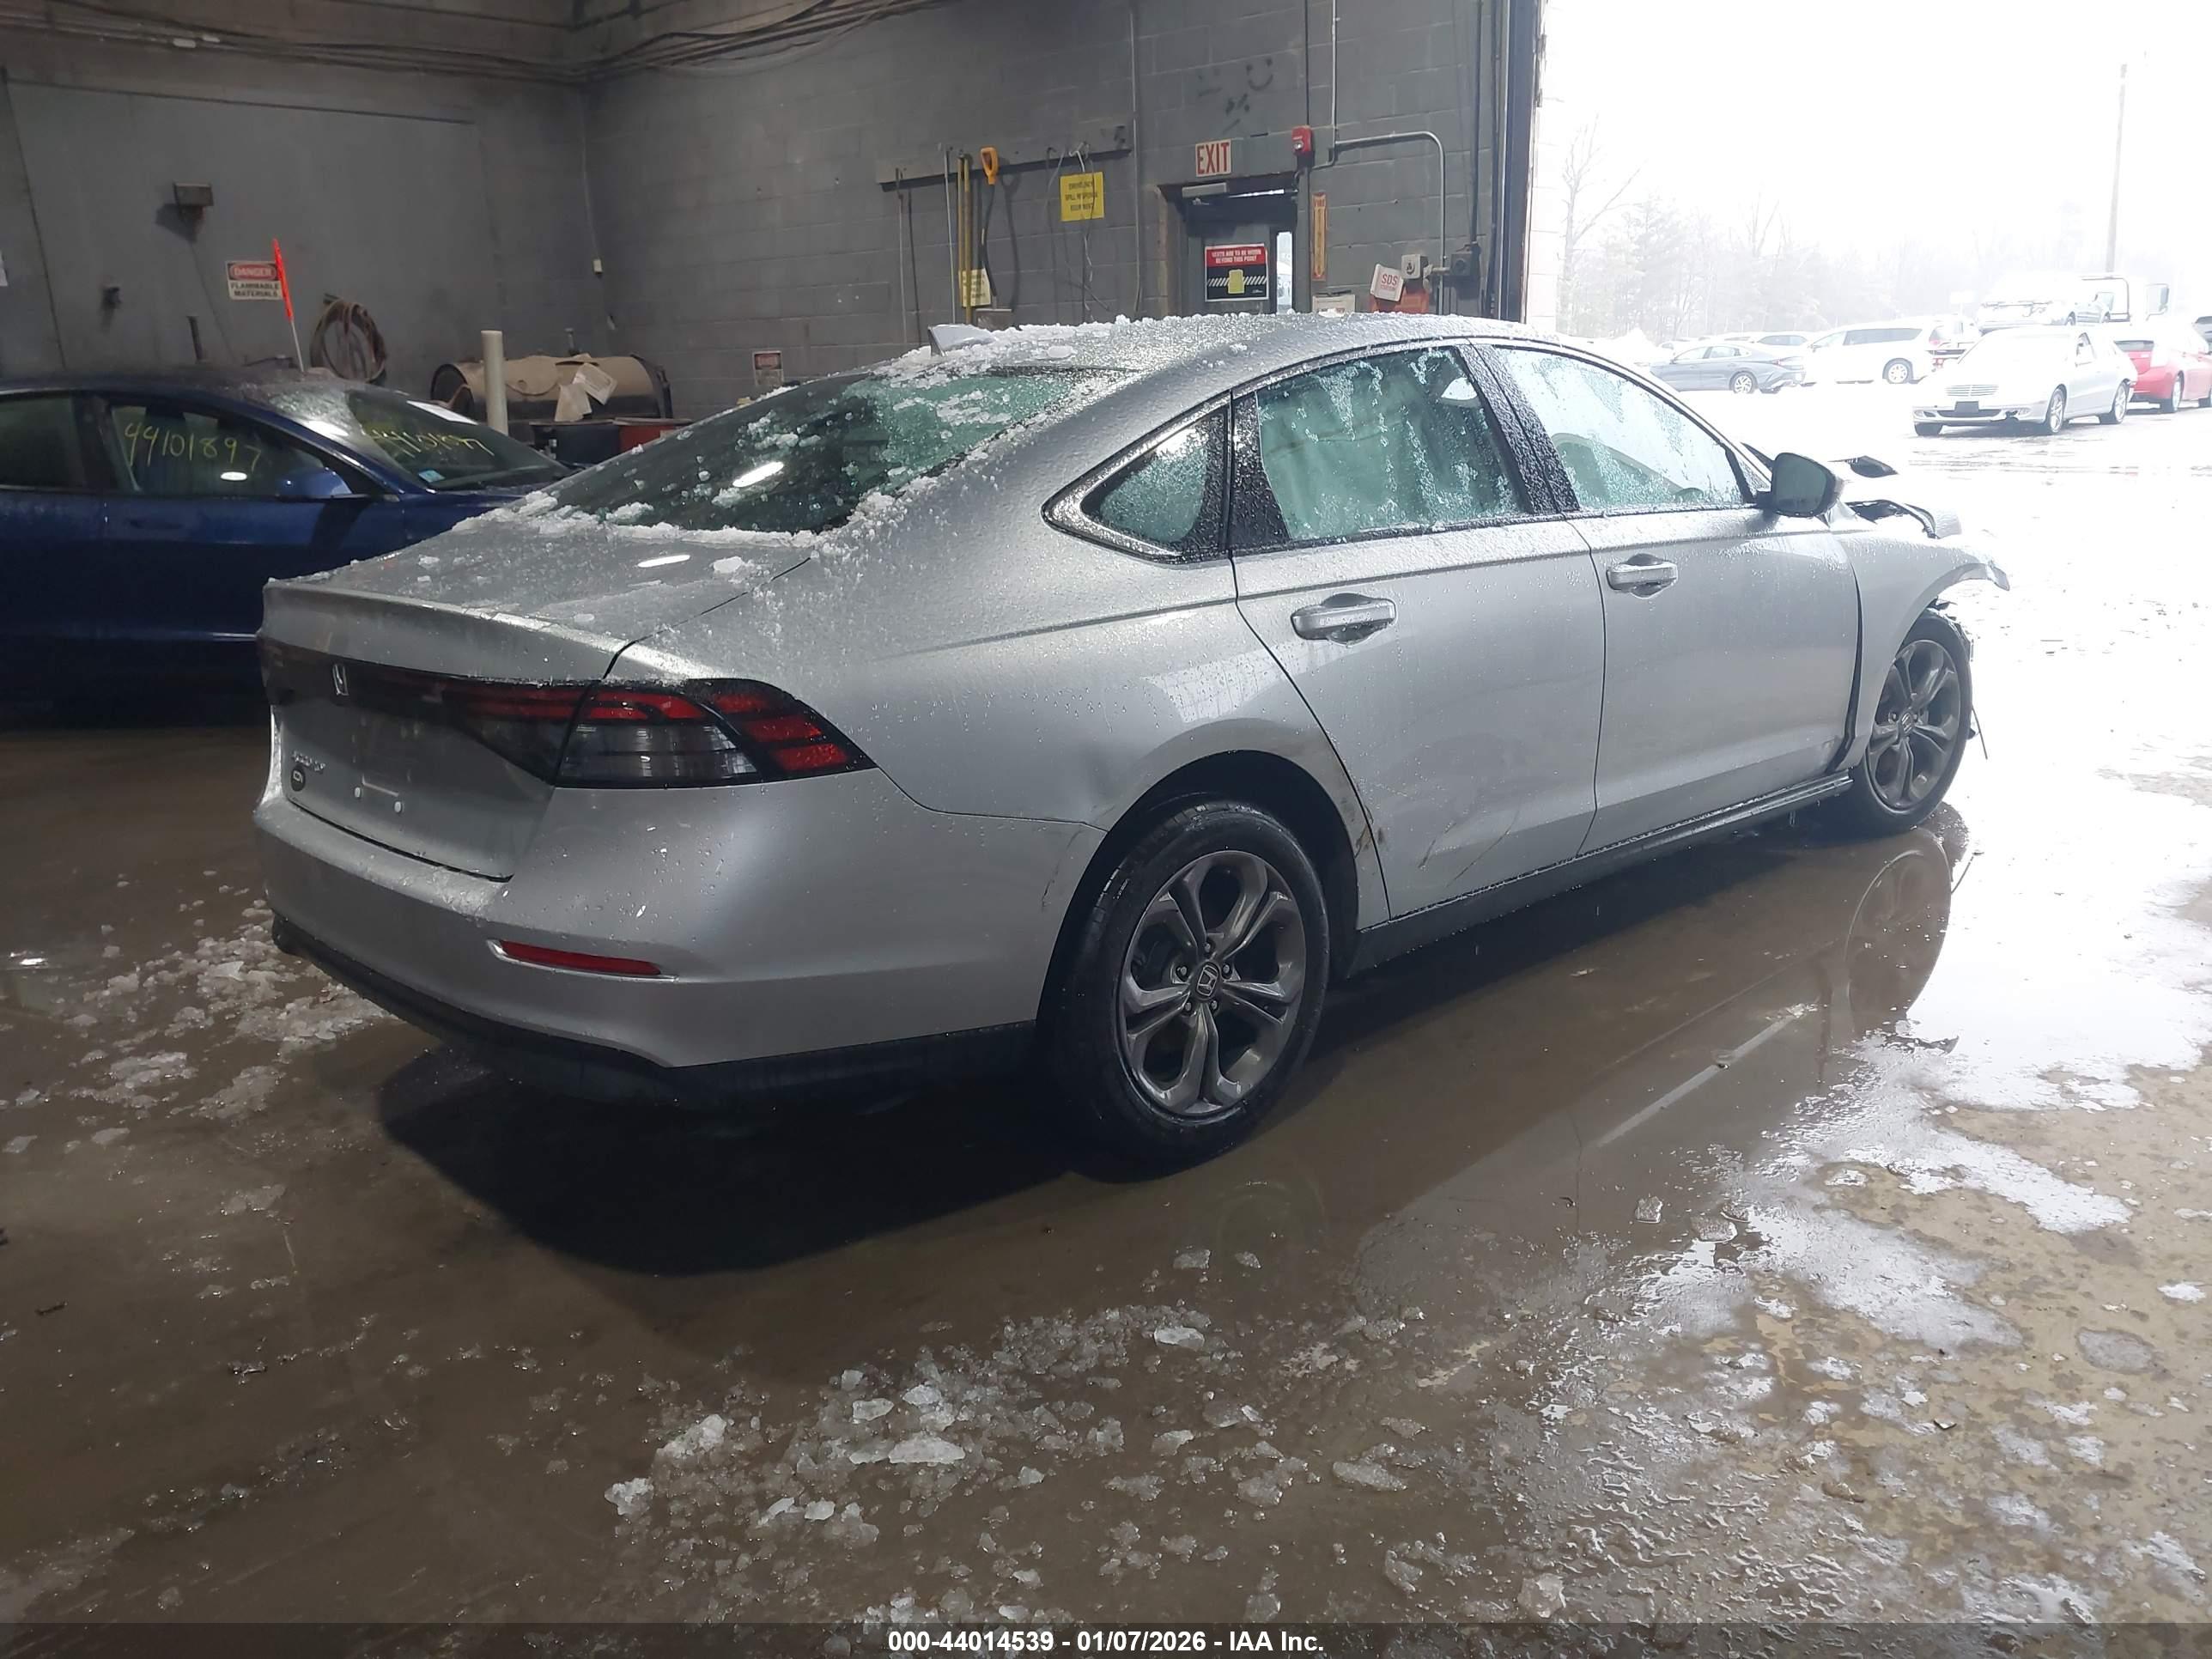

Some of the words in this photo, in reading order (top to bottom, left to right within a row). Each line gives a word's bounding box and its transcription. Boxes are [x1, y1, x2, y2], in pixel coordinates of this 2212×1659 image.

[1196, 142, 1230, 174] EXIT
[234, 267, 273, 276] DANGER
[1381, 273, 1399, 286] SDS
